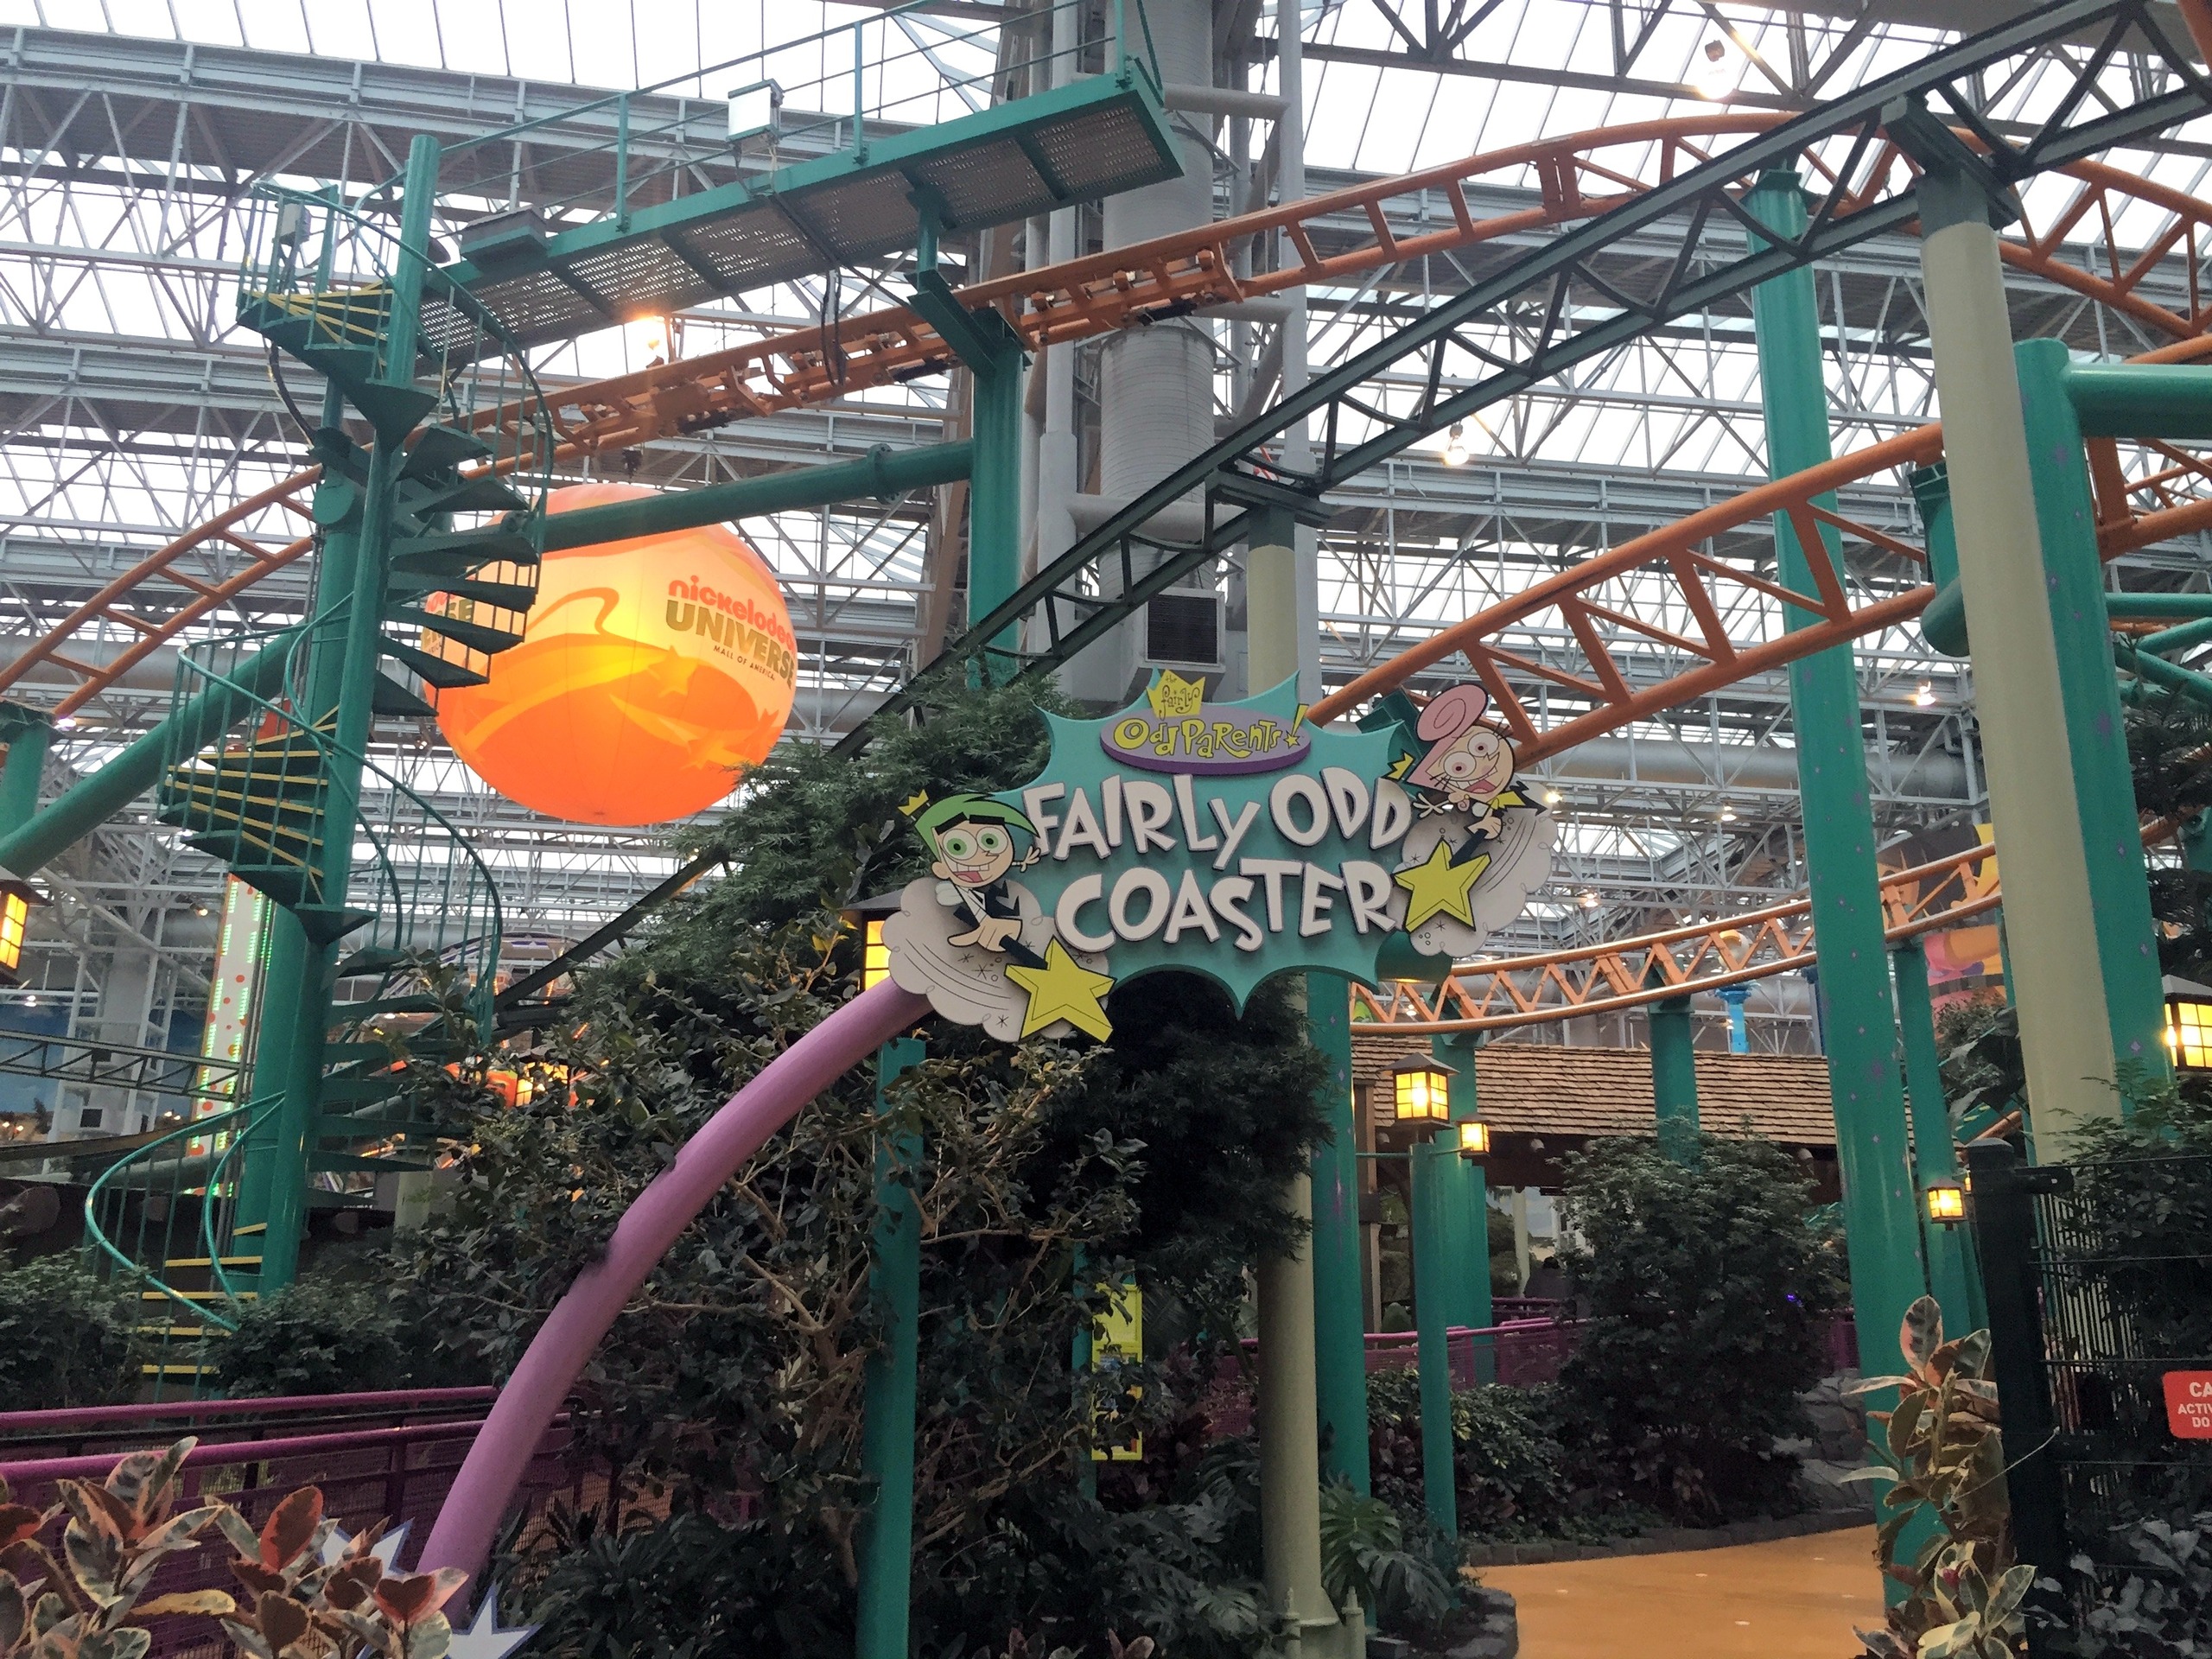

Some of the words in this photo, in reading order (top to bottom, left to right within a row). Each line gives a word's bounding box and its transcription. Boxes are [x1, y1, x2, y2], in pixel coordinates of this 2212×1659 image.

[667, 575, 795, 655] nickelodeo
[713, 645, 734, 660] MALL
[737, 656, 747, 666] OF
[749, 662, 776, 681] AMERICA
[1159, 684, 1201, 721] fairly
[1022, 773, 1262, 870] FAIRLY
[1268, 766, 1412, 849] ODD
[1054, 857, 1397, 953] COASTER
[2191, 1416, 2210, 1428] DO
